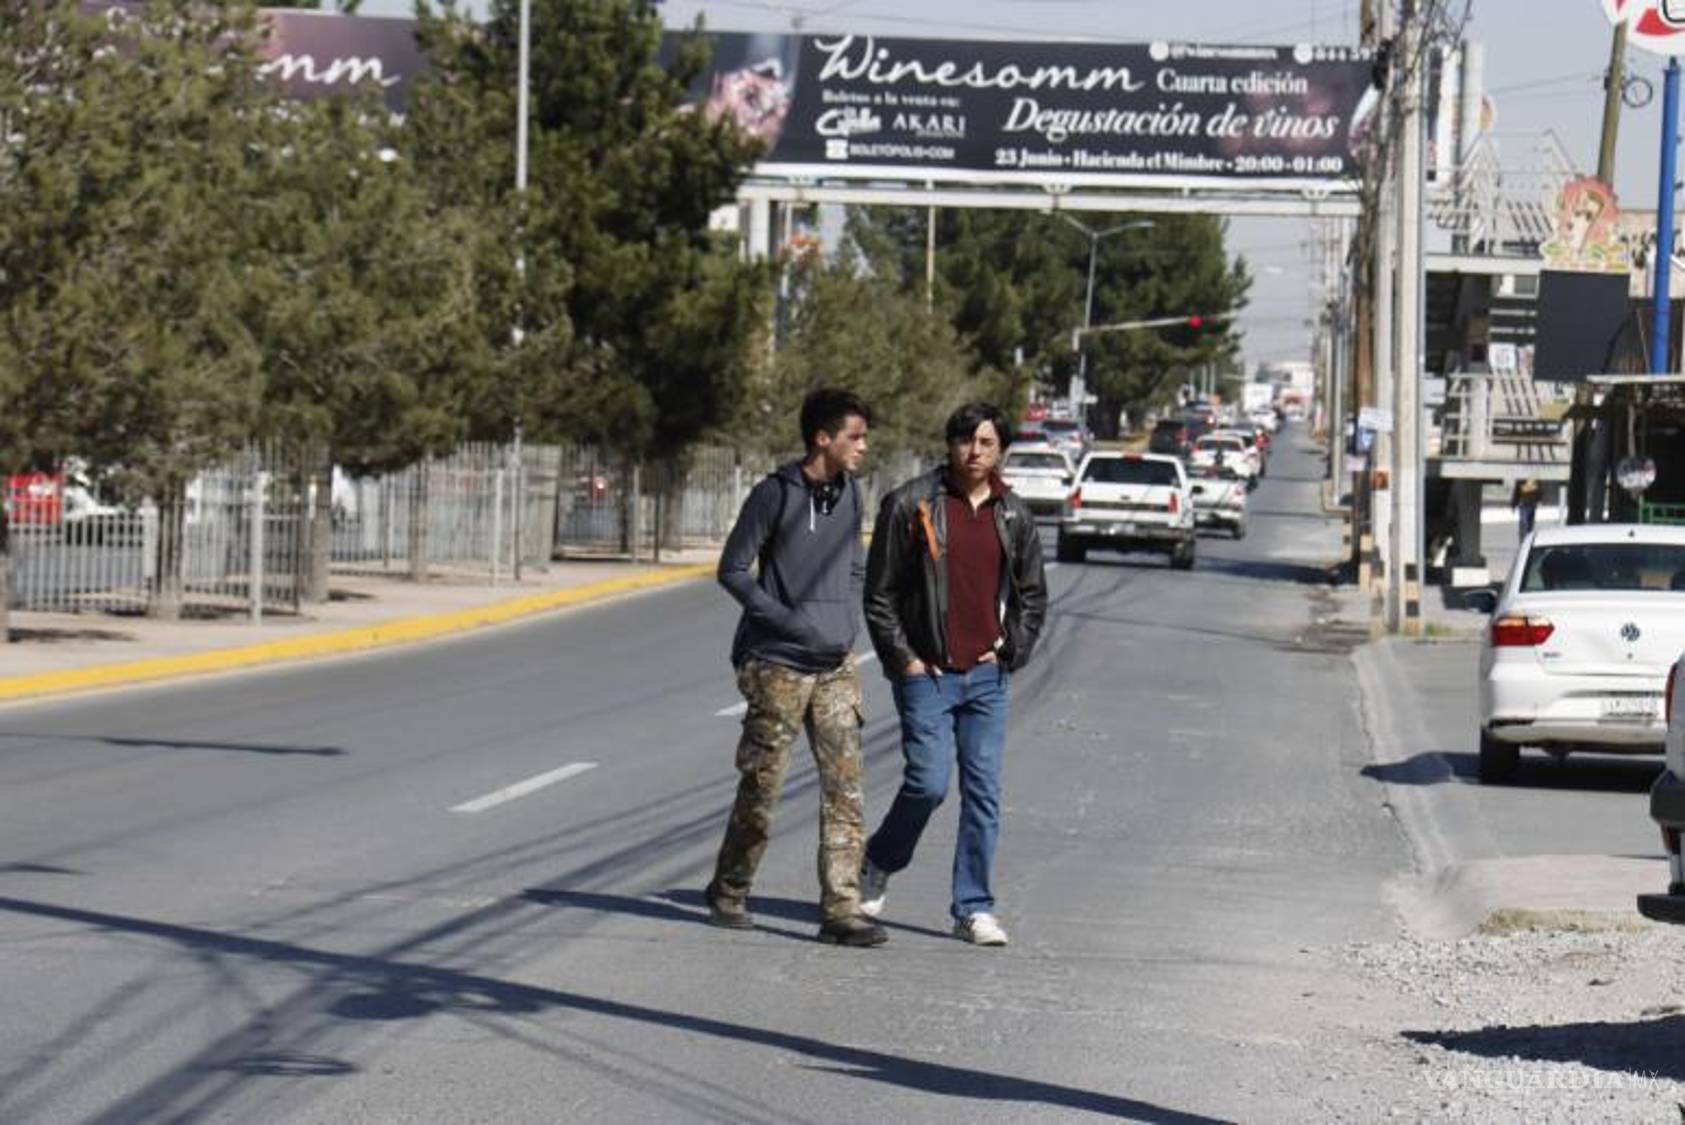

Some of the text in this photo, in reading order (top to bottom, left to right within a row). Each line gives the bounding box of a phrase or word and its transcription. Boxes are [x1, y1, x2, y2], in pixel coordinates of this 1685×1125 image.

[813, 35, 1145, 91] Winesomm
[1156, 68, 1309, 94] Cuarta edición
[892, 112, 966, 134] AKARI
[1002, 97, 1340, 142] Degustación de vinos
[995, 147, 1343, 173] 23 Junio Hacienda el Mimbre 20:00 01:00
